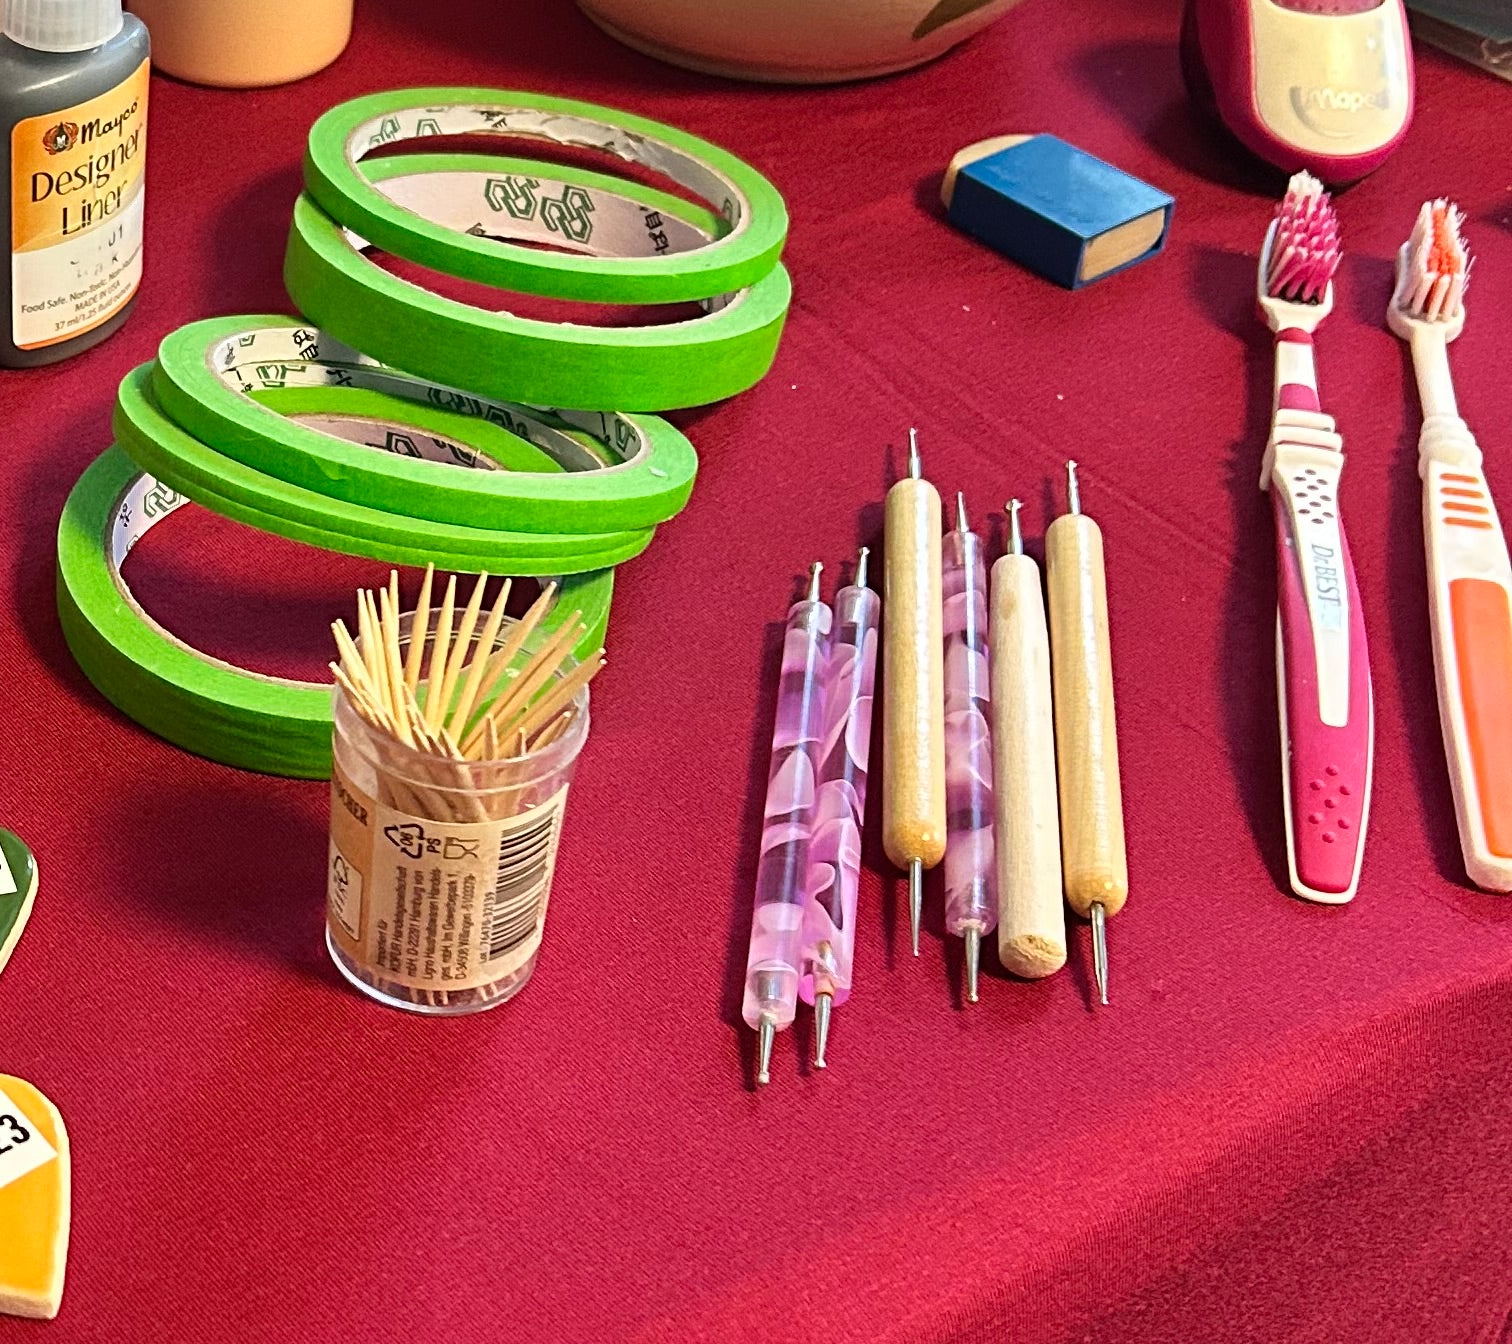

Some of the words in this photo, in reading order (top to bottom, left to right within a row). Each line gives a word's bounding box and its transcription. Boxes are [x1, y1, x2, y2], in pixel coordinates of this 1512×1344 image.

[81, 101, 139, 144] Mayco
[32, 128, 140, 202] Designer
[62, 183, 125, 235] Liner
[21, 301, 45, 313] Food
[427, 838, 441, 854] PS
